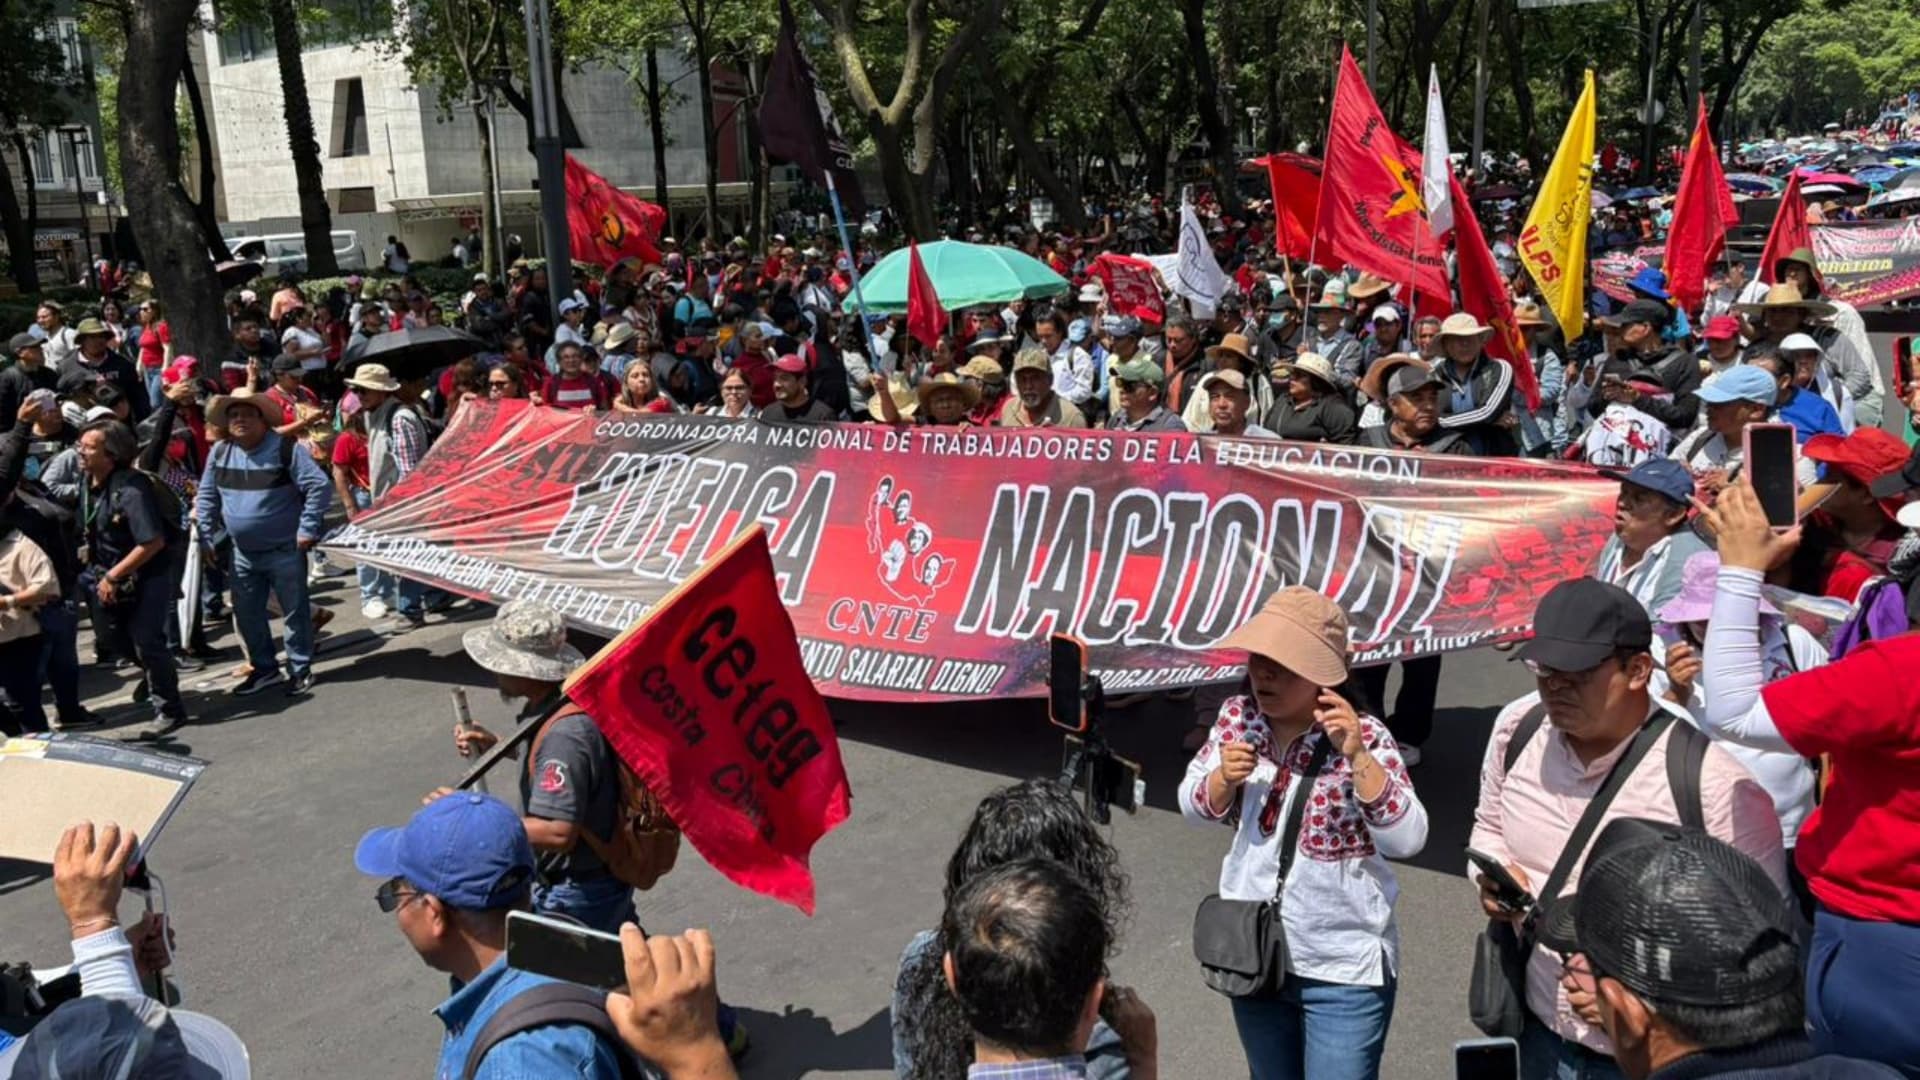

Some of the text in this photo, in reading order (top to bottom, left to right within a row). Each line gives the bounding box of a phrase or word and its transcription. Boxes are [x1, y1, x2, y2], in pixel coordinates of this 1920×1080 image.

[595, 421, 1421, 484] COORDINADORA NACIONAL DE TRABAJADORES DE LA EDUCACIÓN
[544, 452, 1464, 650] HUELGA NACIONAL
[517, 574, 548, 602] LA
[546, 583, 583, 614] LEY
[577, 591, 616, 624] DEL
[797, 639, 843, 678] ENTO
[840, 648, 935, 690] SALARIAL
[930, 661, 1006, 694] DIGNO!
[827, 597, 937, 643] CNTE
[638, 664, 708, 747] Costa
